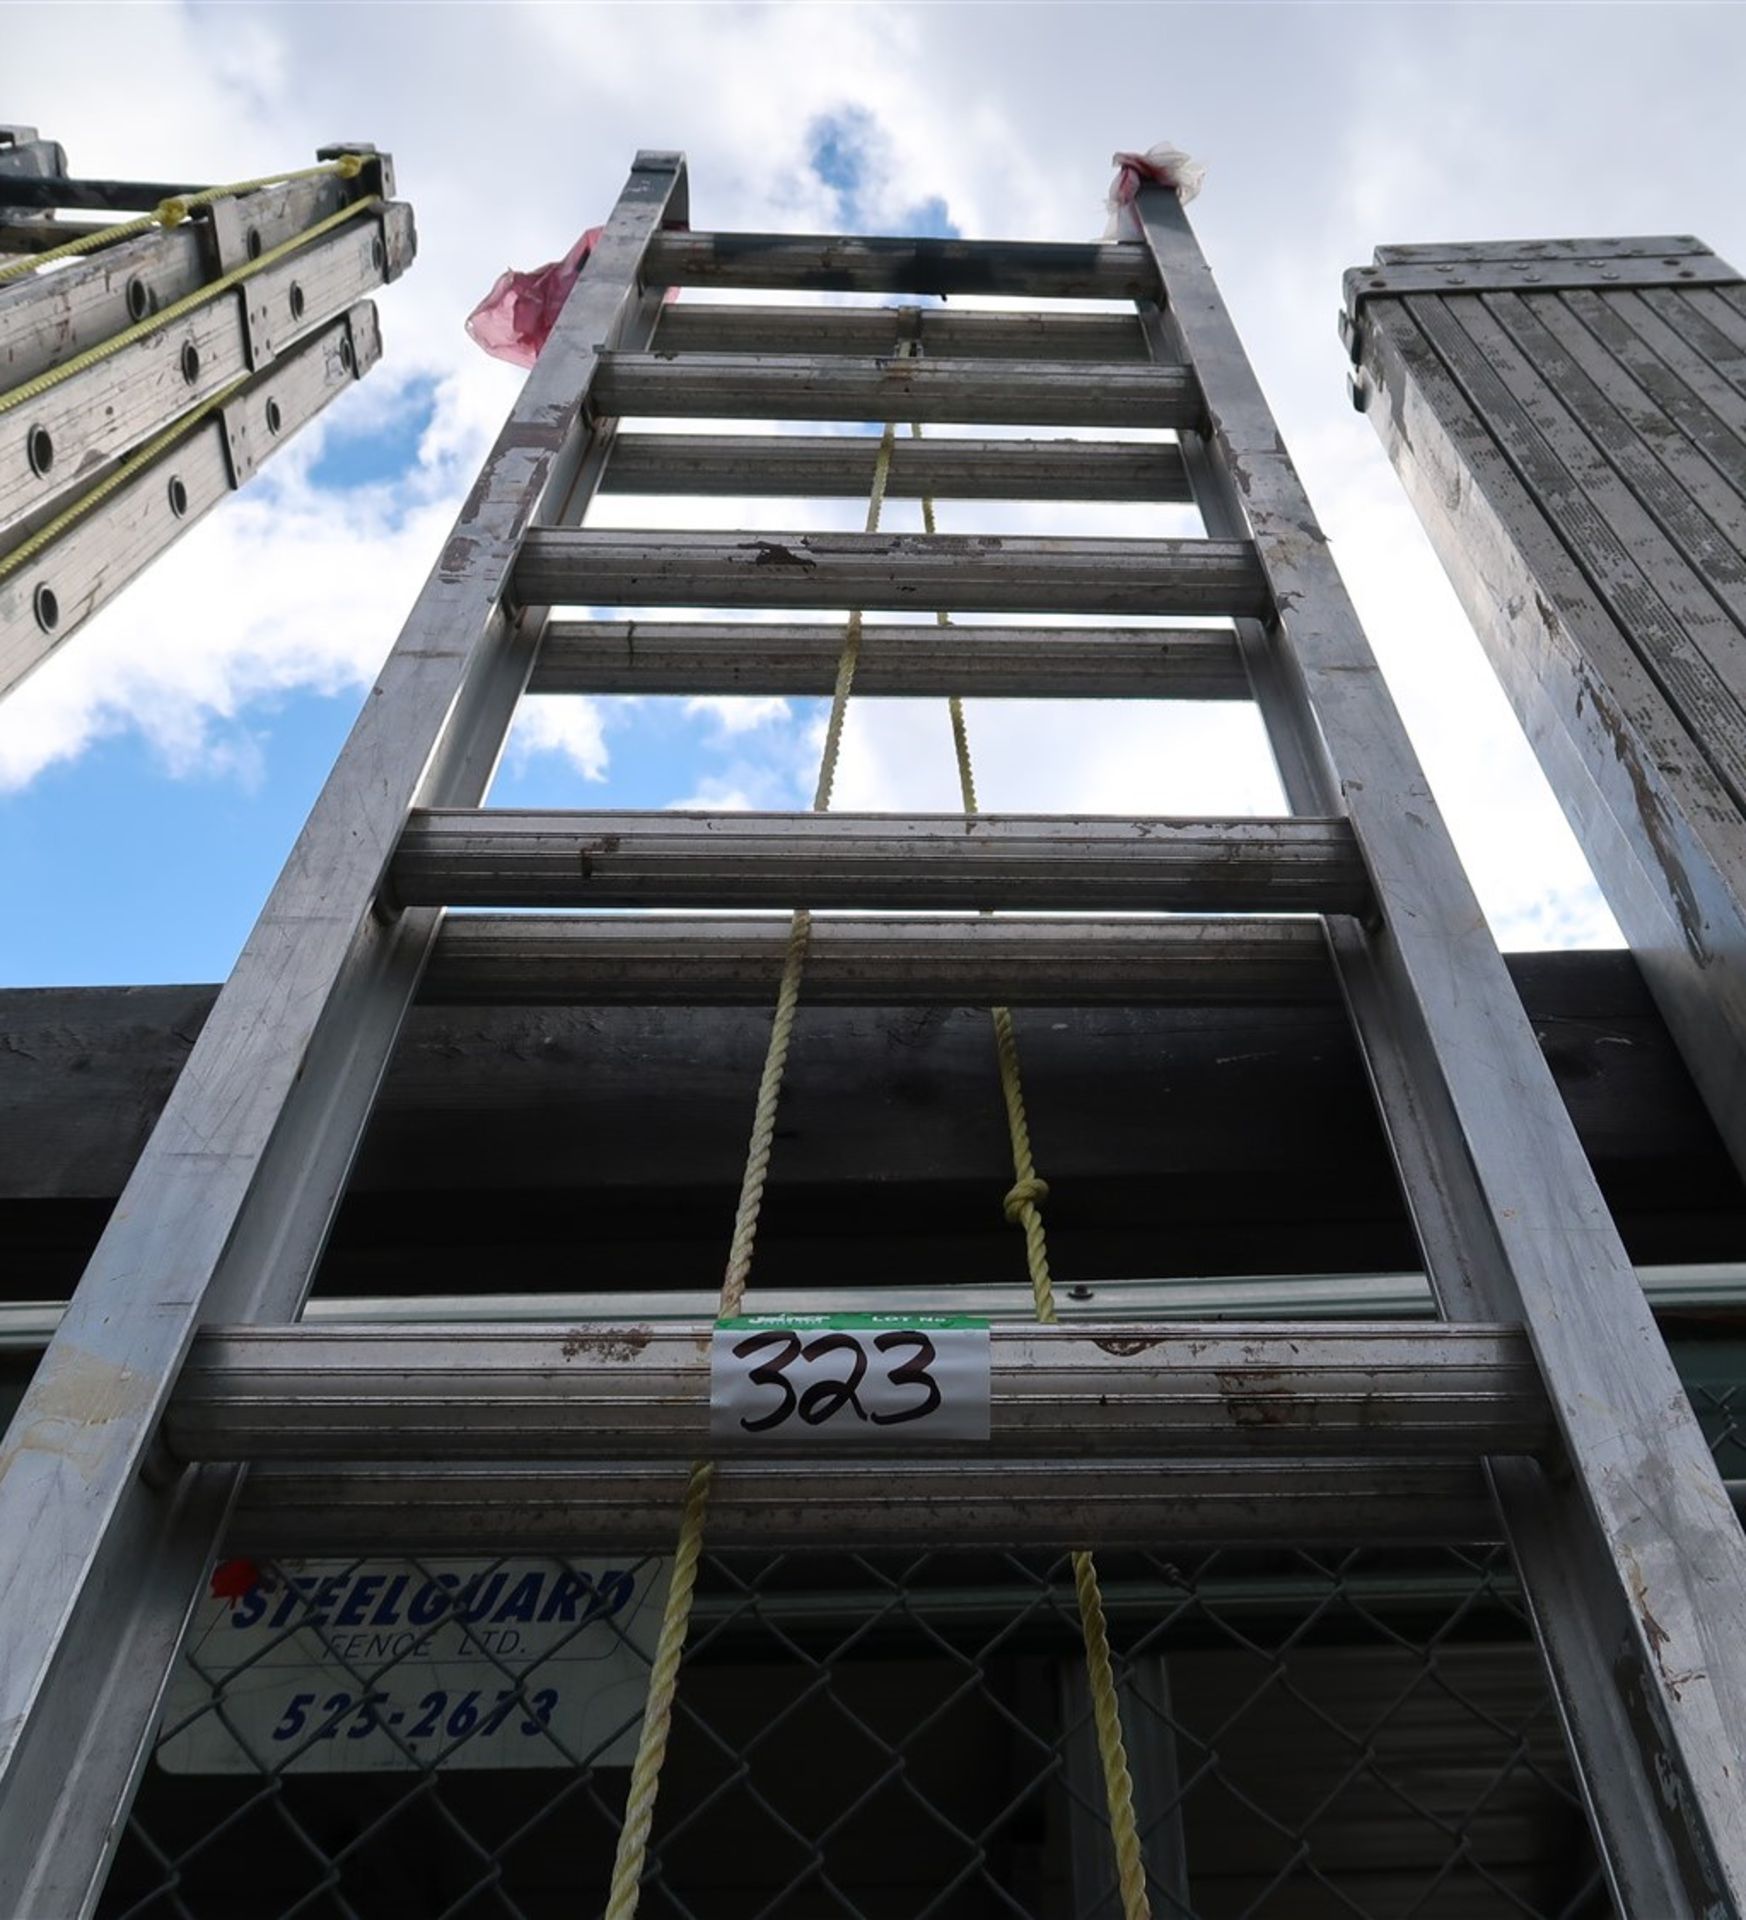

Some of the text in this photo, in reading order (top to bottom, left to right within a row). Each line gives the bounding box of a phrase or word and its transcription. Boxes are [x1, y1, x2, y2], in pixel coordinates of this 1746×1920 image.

[732, 1330, 942, 1432] 323
[231, 1571, 637, 1629] STEELGUARD
[322, 1629, 527, 1660] FENCE LTD.
[273, 1688, 559, 1741] 525-2673
